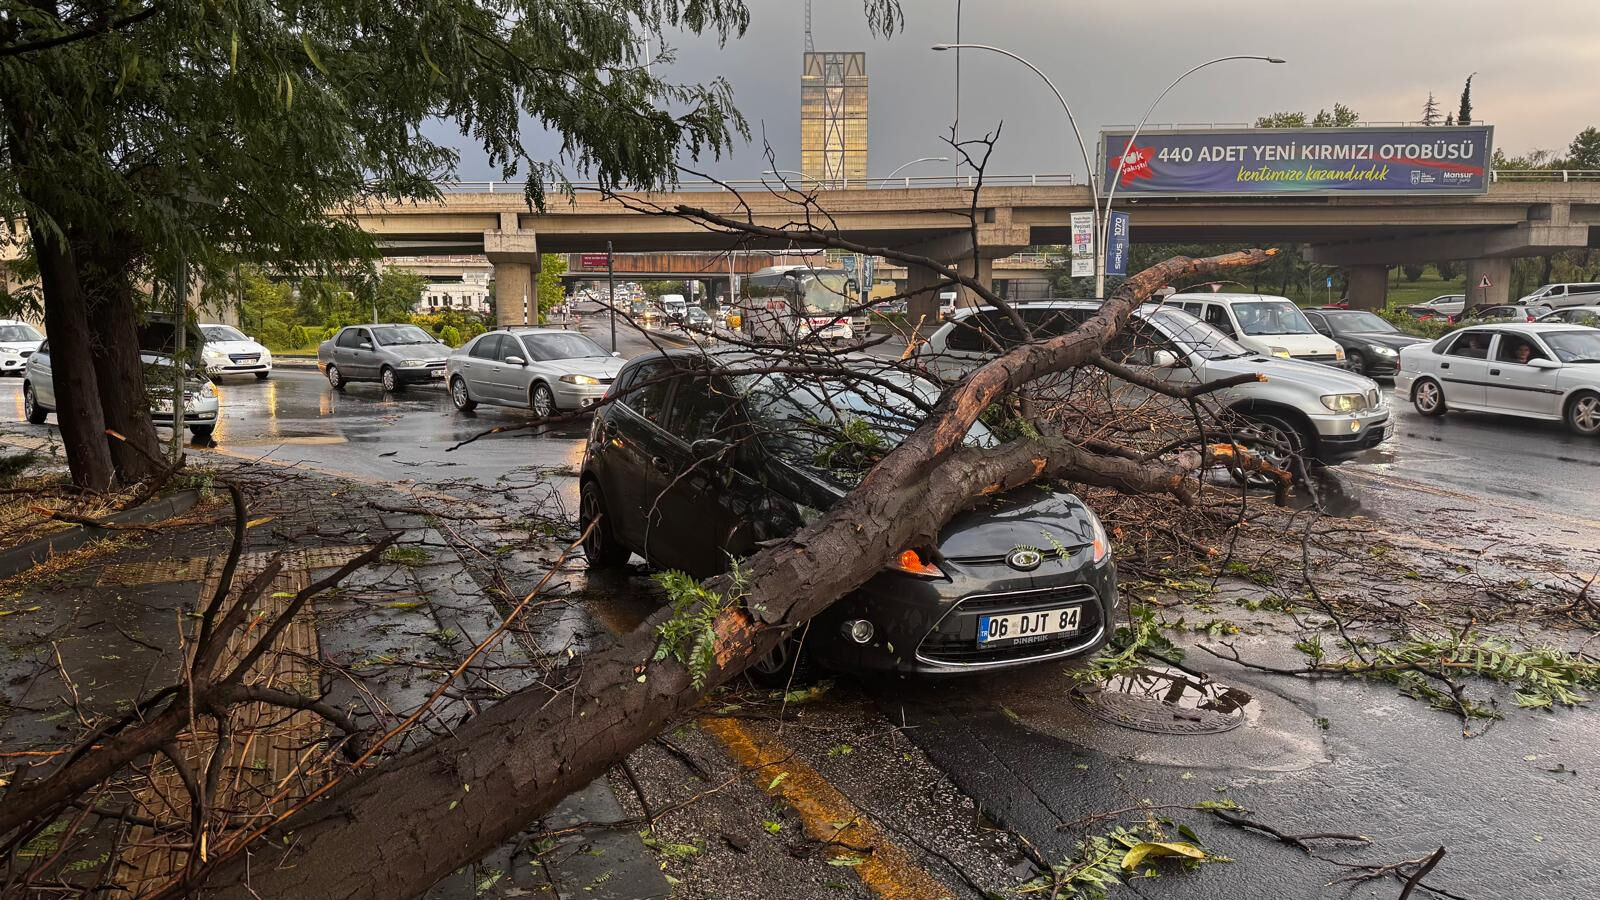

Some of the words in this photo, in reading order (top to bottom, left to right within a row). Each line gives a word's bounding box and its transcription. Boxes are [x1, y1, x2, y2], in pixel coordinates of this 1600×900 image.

[1158, 147, 1193, 162] 440
[1197, 146, 1247, 162] ADET
[1252, 141, 1296, 161] YENİ
[1301, 144, 1374, 160] KIRMIZI
[1379, 140, 1474, 160] OTOBÜSÜ
[1237, 165, 1304, 182] kentimize
[1306, 164, 1390, 181] kazandırdık
[1443, 171, 1473, 179] Mansur
[1114, 217, 1122, 236] 1070
[988, 618, 1009, 638] 06
[1020, 613, 1049, 634] DJT
[1058, 609, 1077, 629] 84
